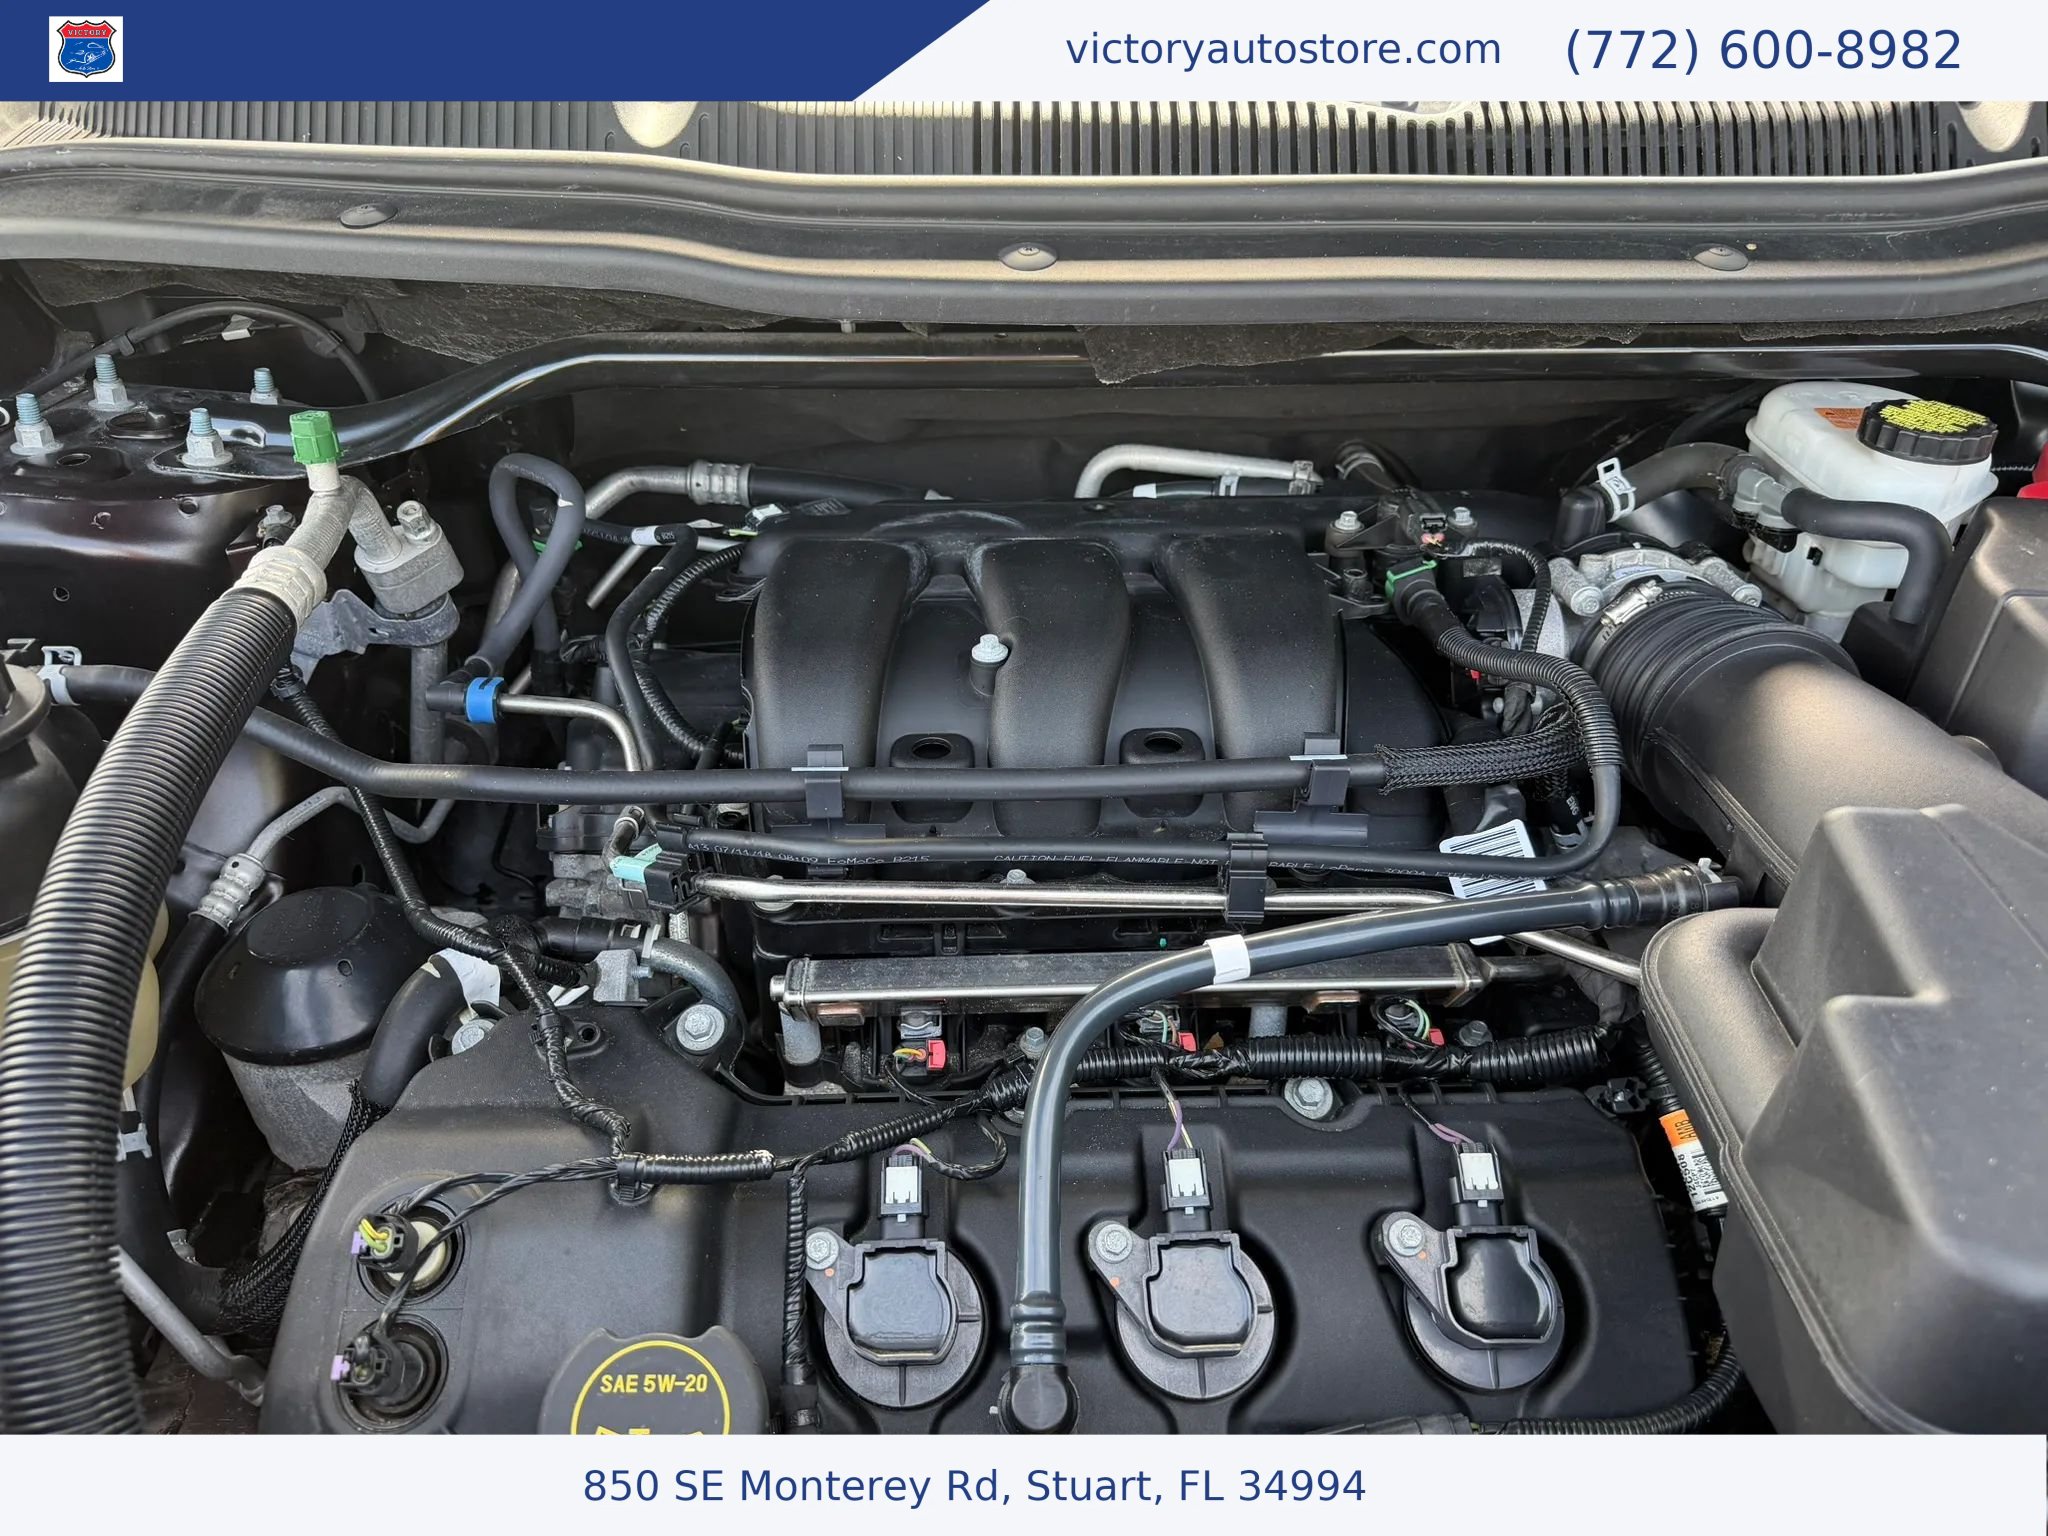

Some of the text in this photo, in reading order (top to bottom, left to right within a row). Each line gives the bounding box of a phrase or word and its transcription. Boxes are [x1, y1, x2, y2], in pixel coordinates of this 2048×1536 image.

[1566, 795, 1579, 816] ENG
[827, 856, 885, 865] FoMoCo
[600, 1373, 708, 1393] SAE 5W-20
